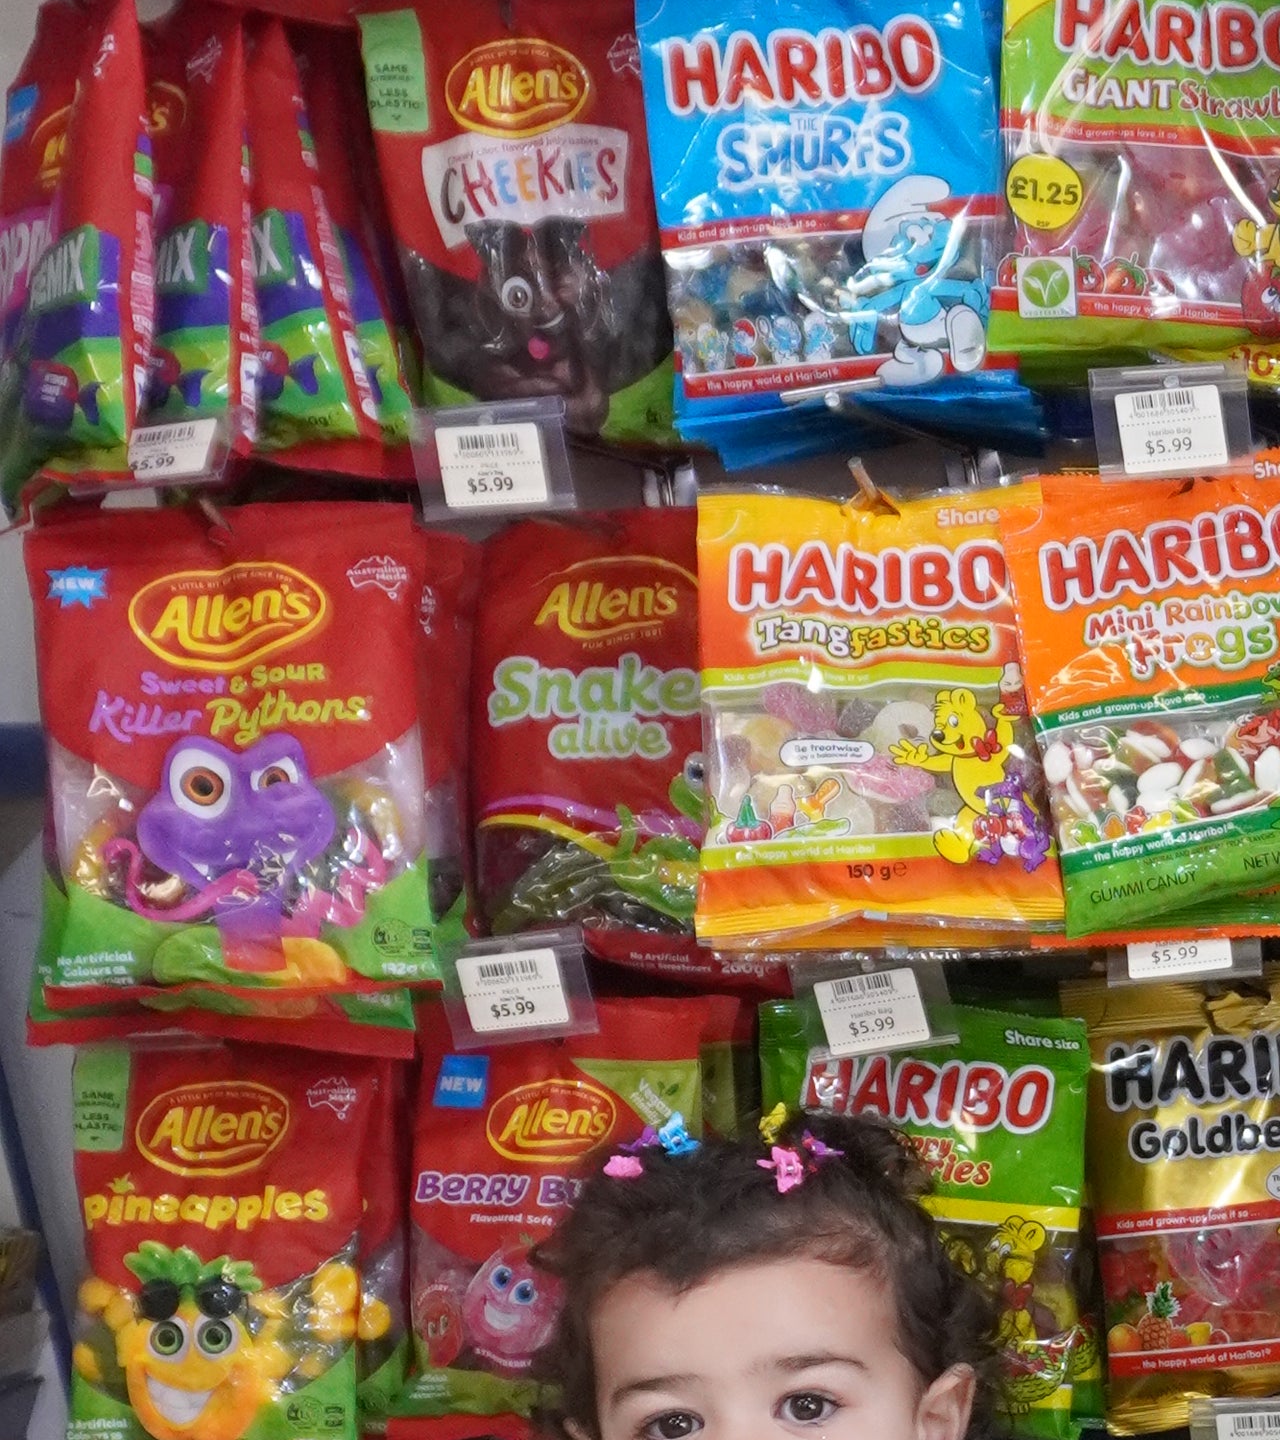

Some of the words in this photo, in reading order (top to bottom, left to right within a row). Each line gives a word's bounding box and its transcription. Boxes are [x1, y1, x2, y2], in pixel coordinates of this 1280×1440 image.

[457, 62, 587, 110] Allen's
[1062, 71, 1174, 113] GIANT
[436, 150, 622, 230] CHEEKIES
[1010, 176, 1080, 210] £1.25
[1145, 435, 1192, 458] $5.99
[155, 586, 312, 647] Allen's
[754, 615, 990, 657] Tangfastics
[1086, 606, 1159, 643] Mini
[1132, 619, 1279, 678] Frogs
[141, 670, 231, 698] Sweet
[89, 691, 205, 744] Killer
[207, 693, 368, 746] Pythons
[549, 717, 673, 760] alive
[490, 999, 536, 1020] $5.99
[83, 1180, 330, 1228] pineapples
[415, 1172, 527, 1207] BERRY
